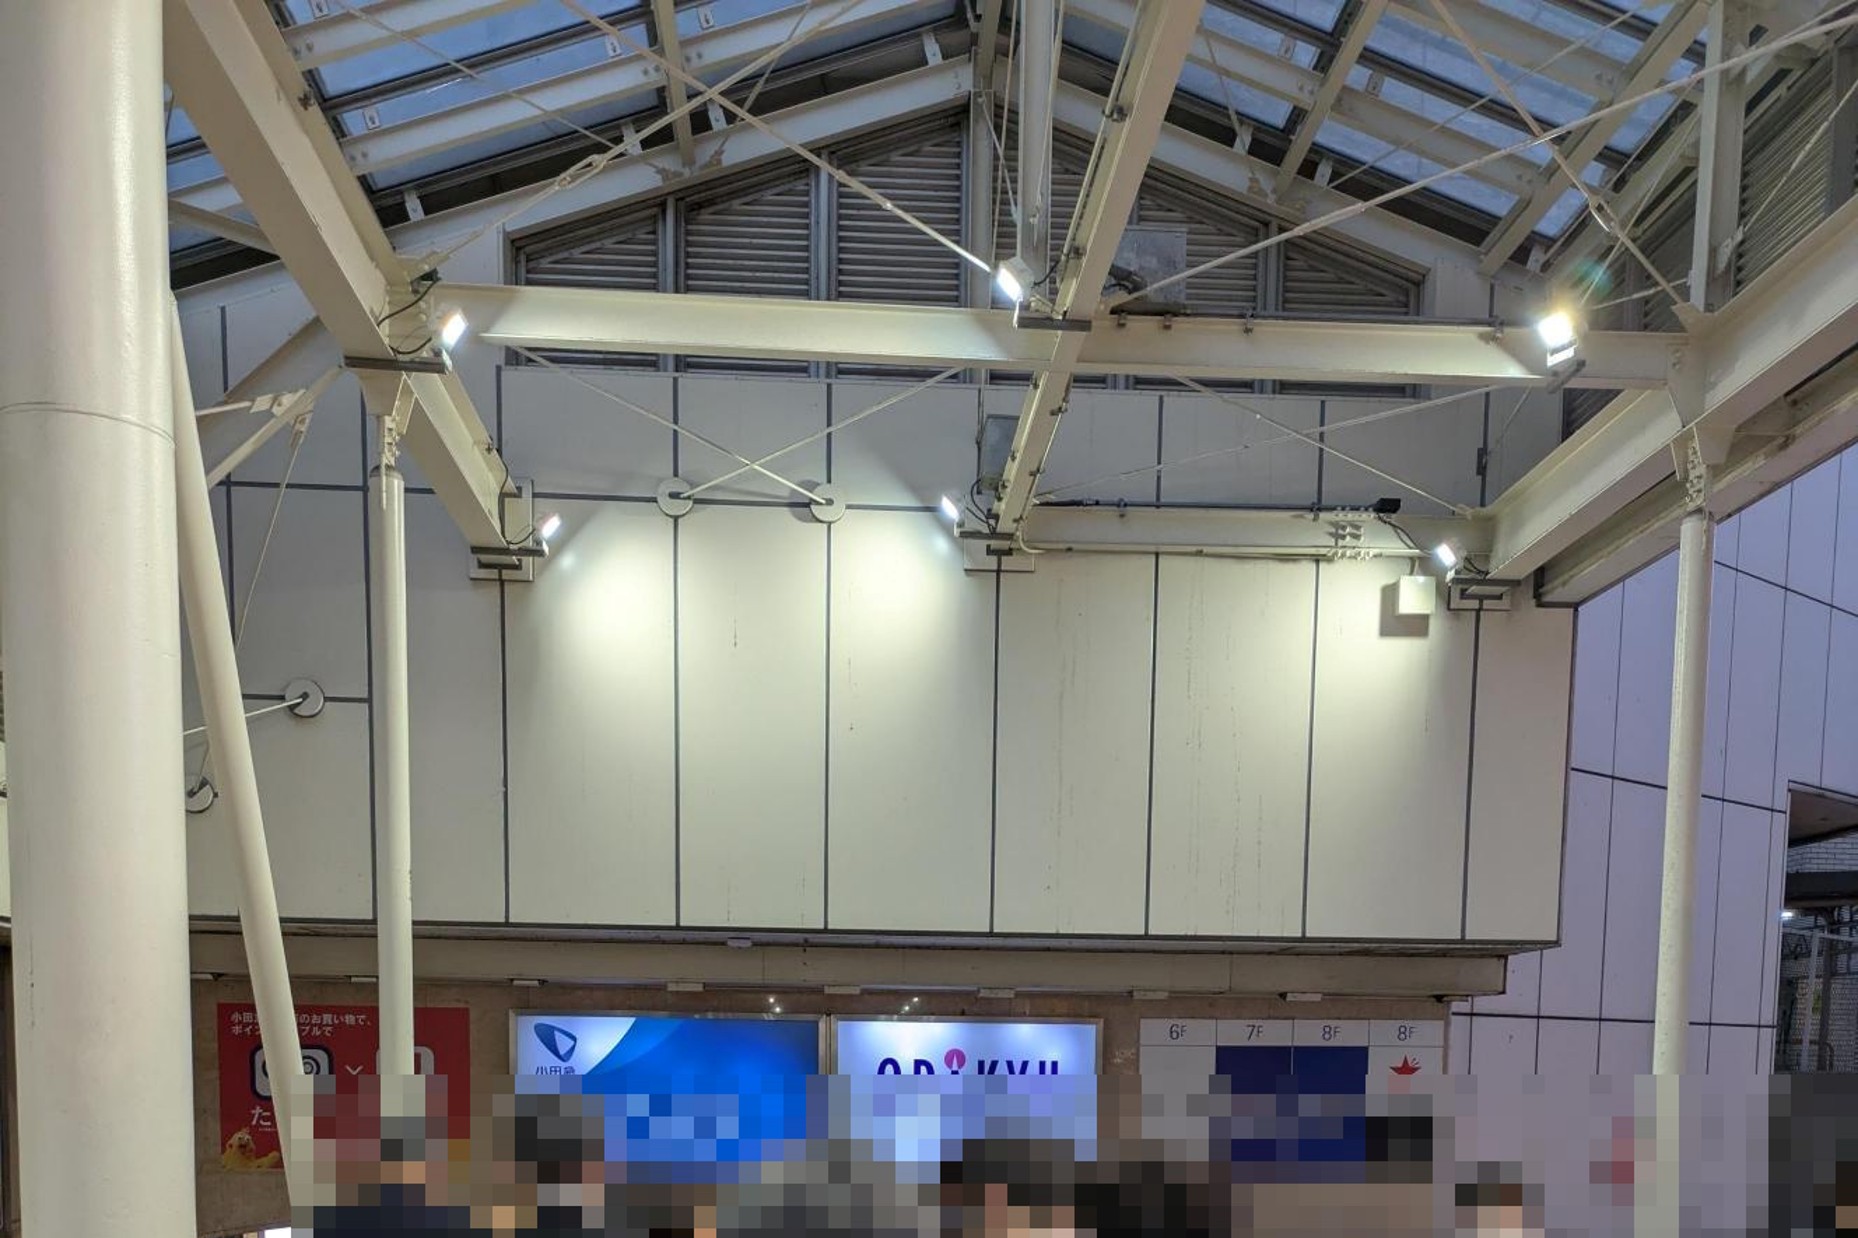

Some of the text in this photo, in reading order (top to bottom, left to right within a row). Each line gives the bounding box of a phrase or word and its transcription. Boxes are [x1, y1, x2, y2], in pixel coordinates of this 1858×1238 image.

[1169, 1024, 1187, 1040] 6F
[1246, 1025, 1264, 1041] 7F
[1322, 1025, 1340, 1041] 8F
[1397, 1025, 1417, 1041] 8F
